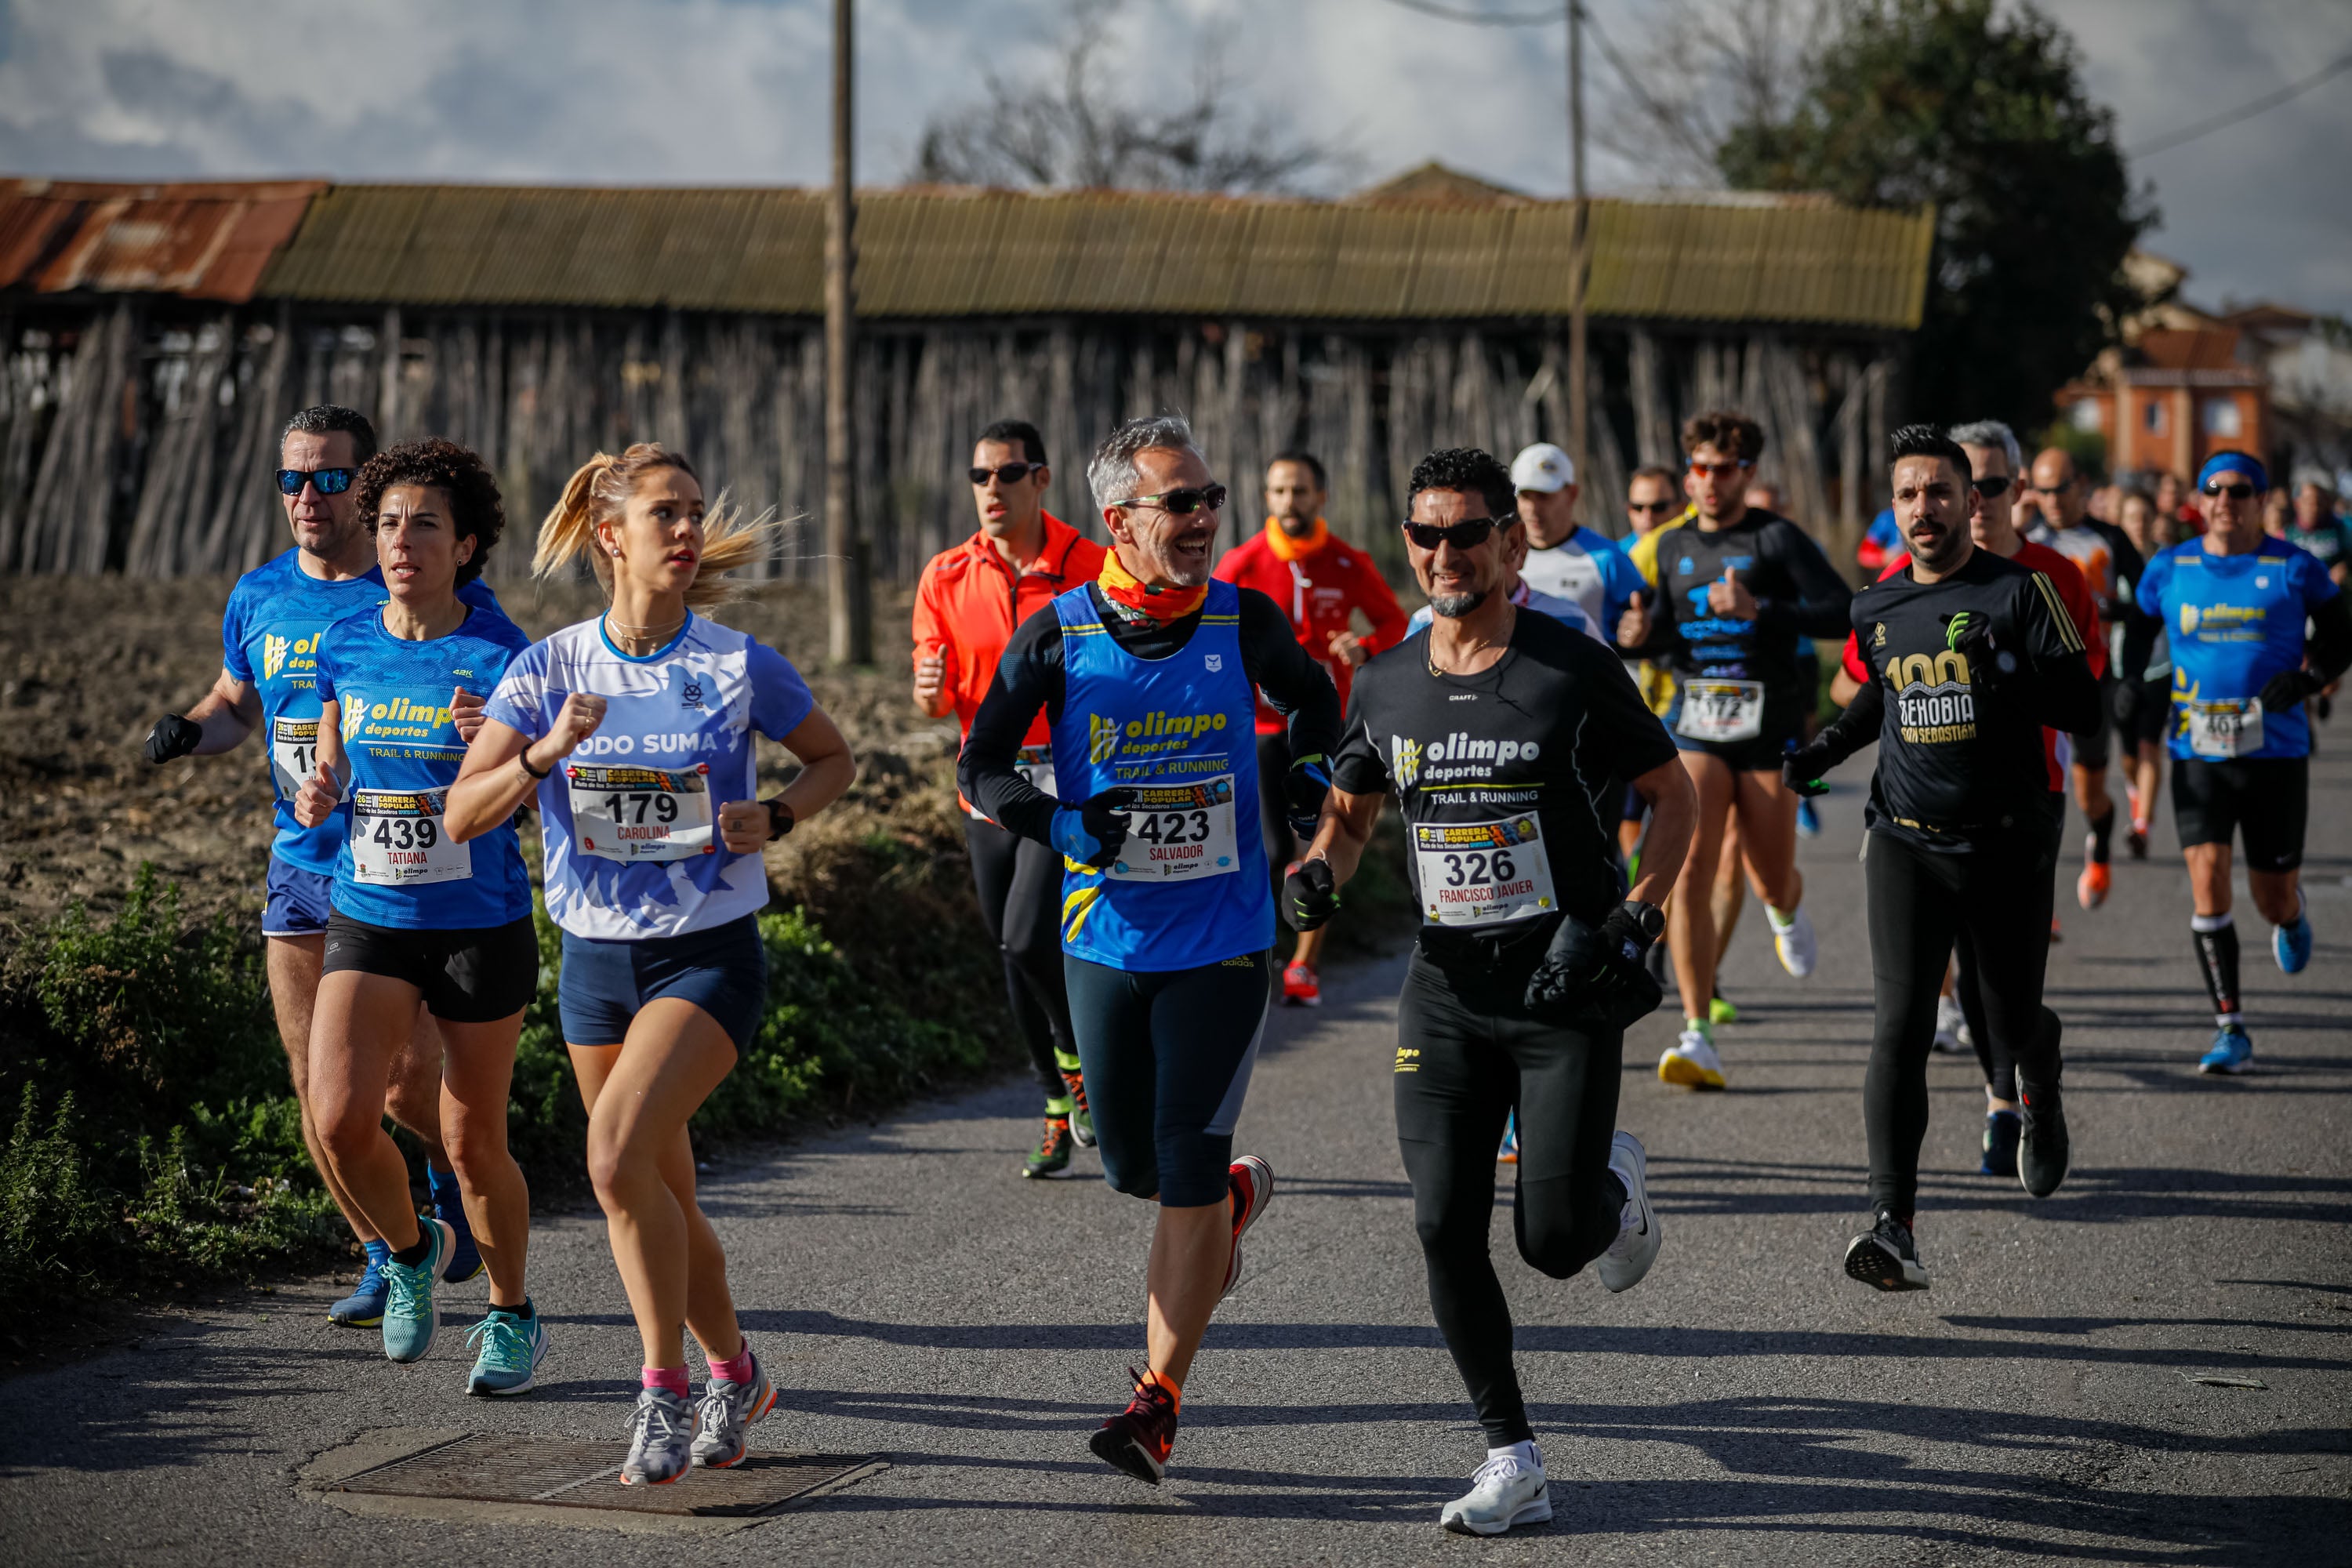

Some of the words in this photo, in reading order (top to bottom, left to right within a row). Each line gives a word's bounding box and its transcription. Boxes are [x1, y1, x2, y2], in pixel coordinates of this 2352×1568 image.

[1885, 650, 1971, 695] 100
[371, 698, 453, 728] olimp
[1898, 694, 1974, 726] BEHOBIA
[365, 723, 429, 738] deportes
[1126, 710, 1227, 739] olimpo
[368, 747, 401, 758] TRAIL
[404, 750, 412, 758] &
[575, 735, 634, 756] ODO
[643, 732, 717, 753] SUMA
[1122, 740, 1189, 756] deportes
[1427, 732, 1540, 766] olimpo
[1115, 766, 1152, 779] TRAIL
[1156, 764, 1165, 775] &
[1168, 758, 1229, 774] RUNNING
[1425, 765, 1492, 782] deportes
[358, 795, 366, 804] 26
[379, 795, 416, 804] CARRERA
[1431, 793, 1467, 805] TRAIL
[1469, 793, 1478, 804] &
[1480, 790, 1538, 804] RUNNING
[604, 793, 678, 823] 179
[374, 818, 437, 849] 439
[618, 826, 670, 840] CAROLINA
[1138, 811, 1210, 844] 423
[1444, 827, 1489, 837] CARRERA
[1446, 834, 1489, 844] POPULAR
[387, 852, 427, 864] TATIANA
[1149, 844, 1203, 861] SALVADOR
[1444, 850, 1515, 887] 326
[1439, 887, 1494, 903] FRANCISCO
[1497, 880, 1534, 899] JAVIER
[1221, 959, 1254, 967] adidas
